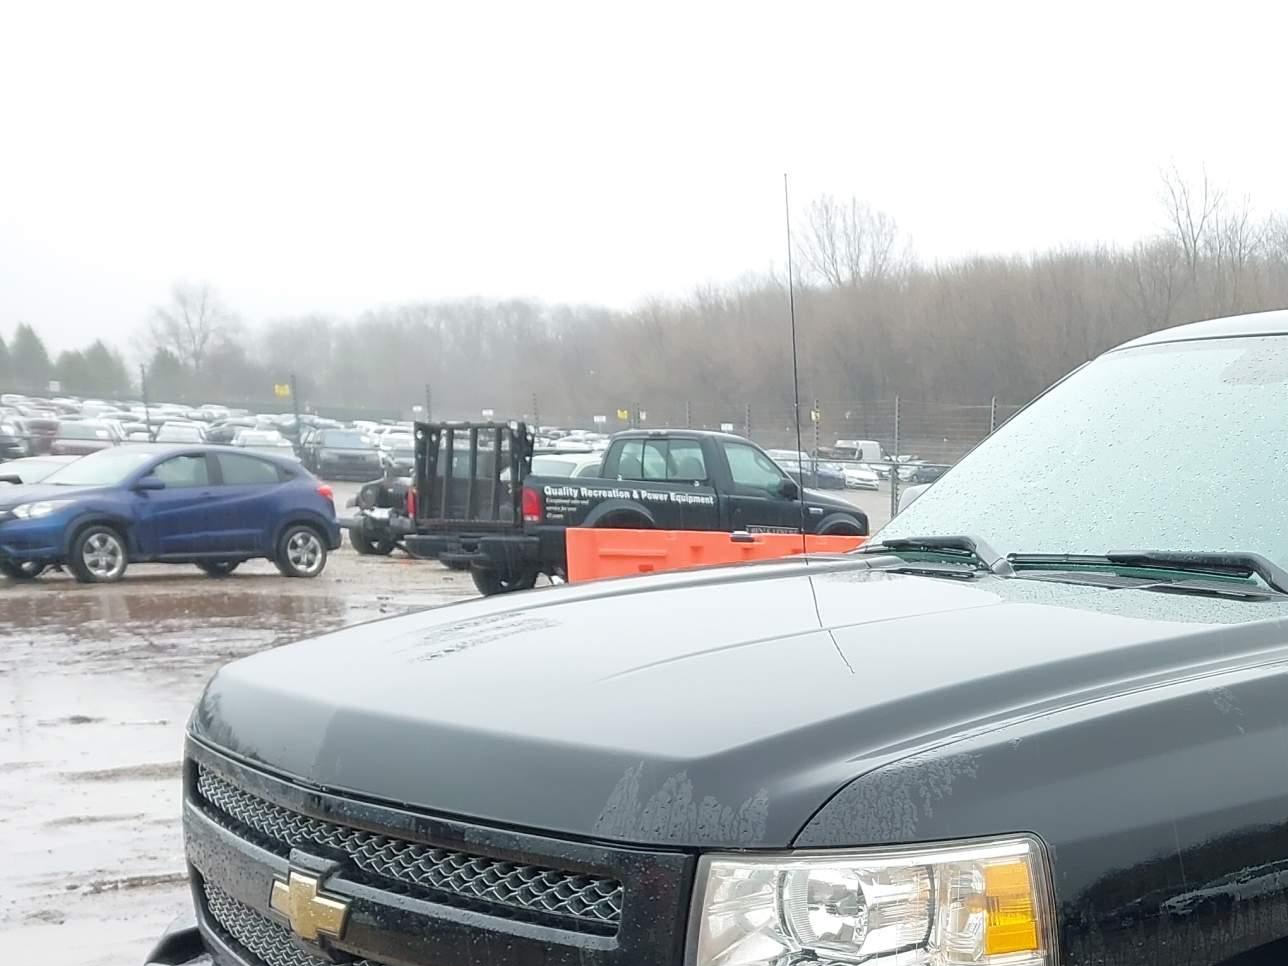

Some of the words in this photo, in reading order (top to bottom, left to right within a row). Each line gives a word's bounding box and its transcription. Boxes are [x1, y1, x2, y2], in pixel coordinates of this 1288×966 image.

[544, 485, 578, 498] Quality
[580, 487, 631, 499] Recreation
[632, 488, 639, 499] &
[641, 490, 668, 501] Power
[670, 492, 714, 504] Equipment
